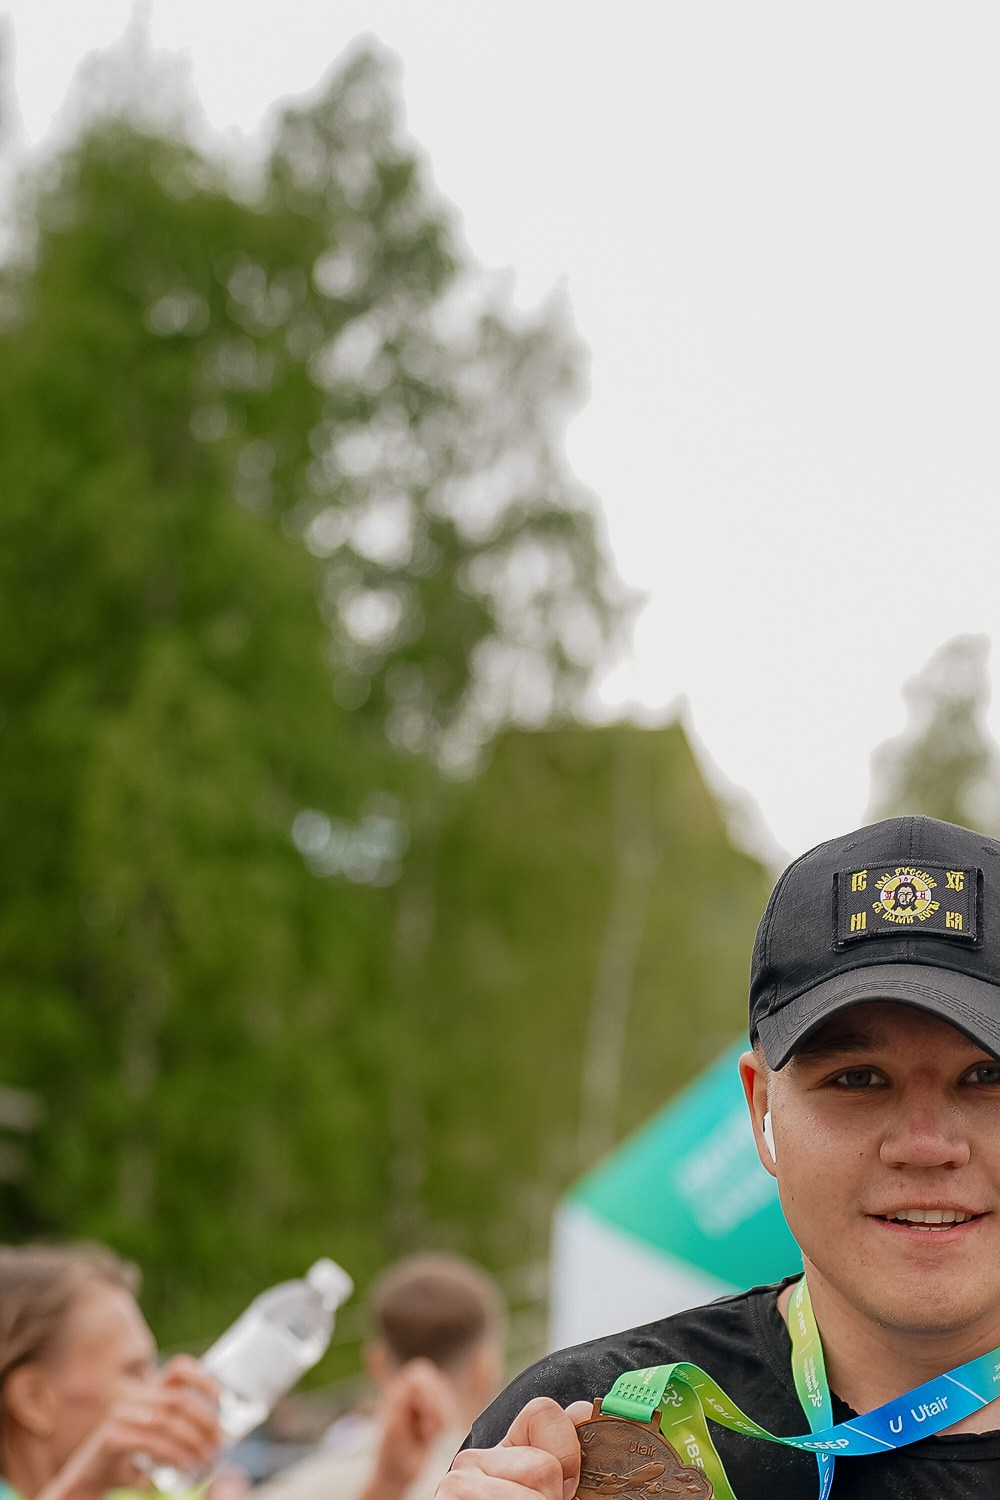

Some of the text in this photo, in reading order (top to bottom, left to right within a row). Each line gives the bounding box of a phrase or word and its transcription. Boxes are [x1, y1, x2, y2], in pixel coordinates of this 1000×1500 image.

[706, 1396, 734, 1421] лет
[911, 1396, 948, 1423] Utair
[628, 1441, 656, 1457] Utair
[803, 1438, 850, 1451] СБЕР
